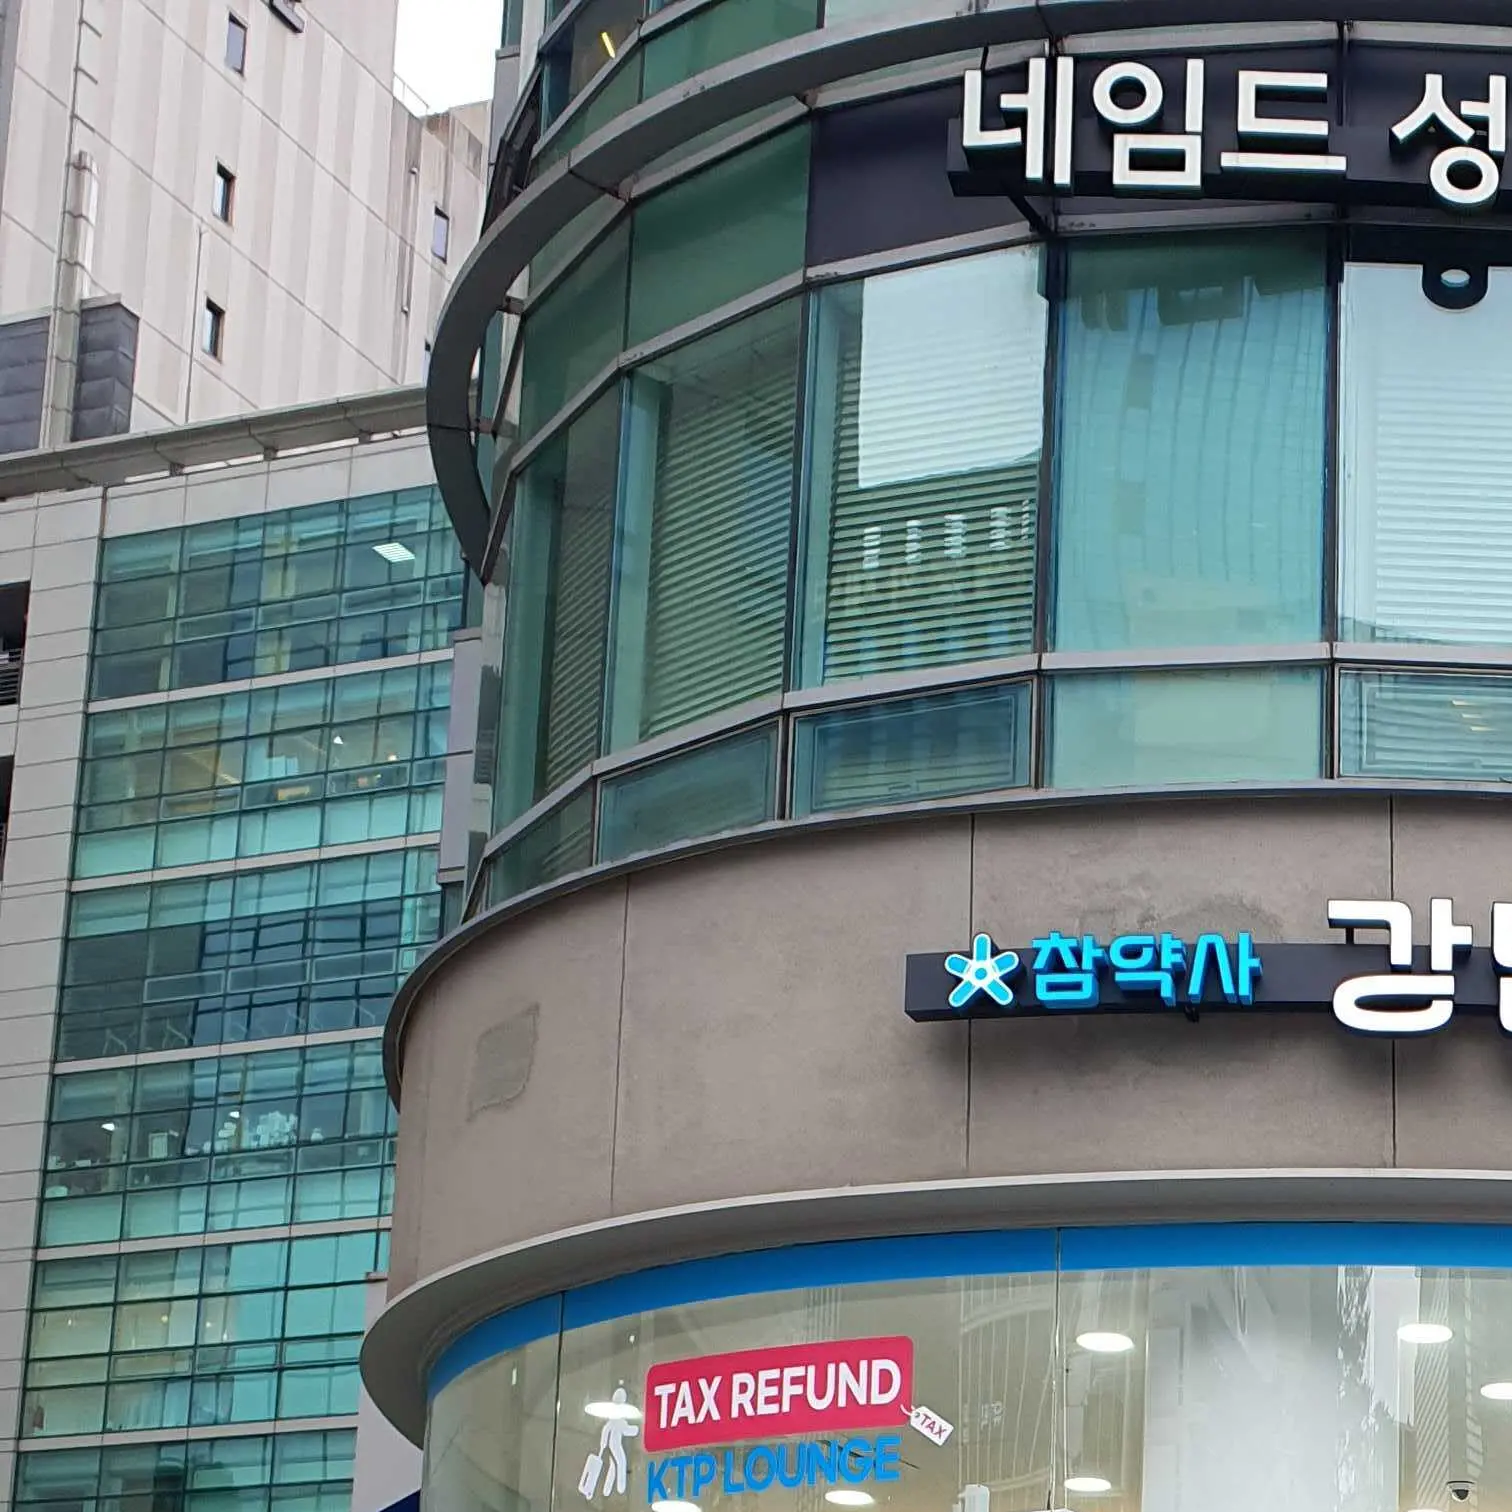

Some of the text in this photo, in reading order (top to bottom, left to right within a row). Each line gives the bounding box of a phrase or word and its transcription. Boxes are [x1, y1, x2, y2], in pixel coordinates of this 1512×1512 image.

[962, 56, 1347, 188] 네임드
[1032, 930, 1262, 1008] 참약사
[653, 1359, 901, 1430] TAX REFUND
[919, 1413, 948, 1440] TAX
[647, 1436, 902, 1505] KTP LOUNGE
